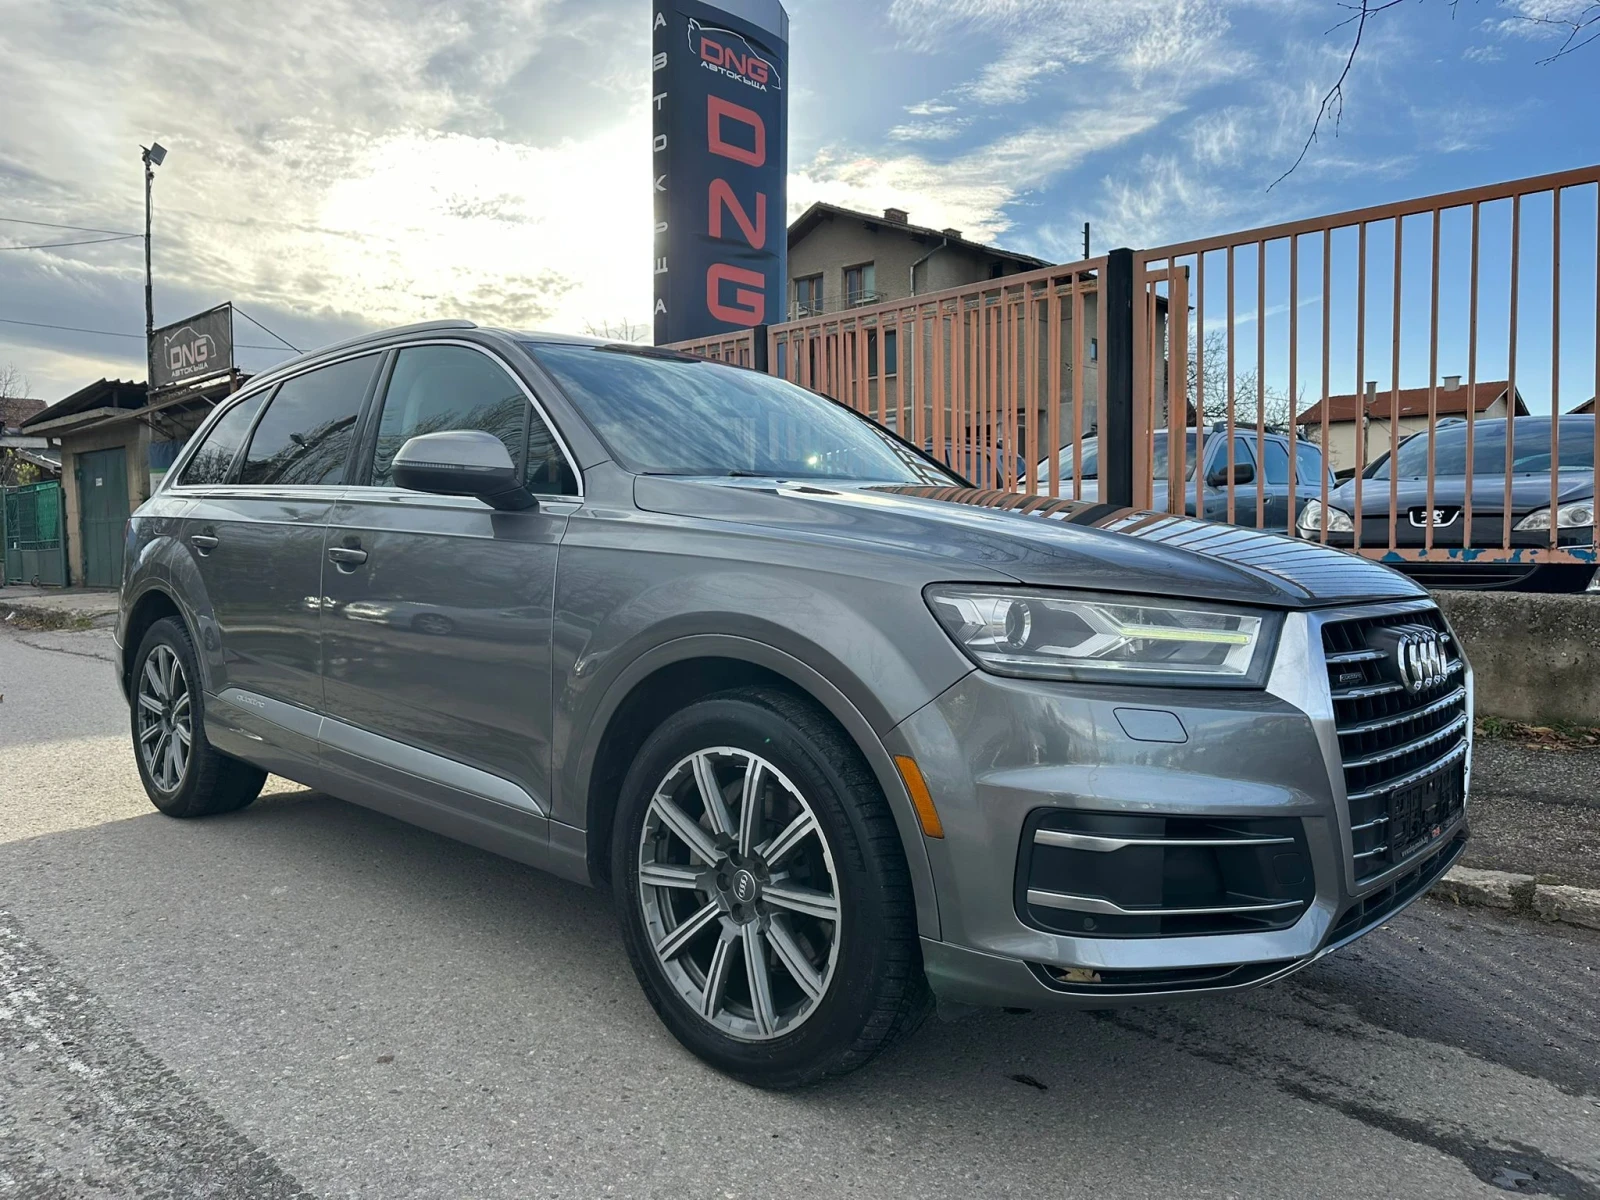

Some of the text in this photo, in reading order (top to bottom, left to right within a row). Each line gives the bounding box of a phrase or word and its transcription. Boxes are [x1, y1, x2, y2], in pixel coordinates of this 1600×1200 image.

[701, 36, 768, 84] DNG
[707, 94, 766, 326] DNG
[170, 338, 207, 370] DNG
[236, 695, 265, 708] quattro
